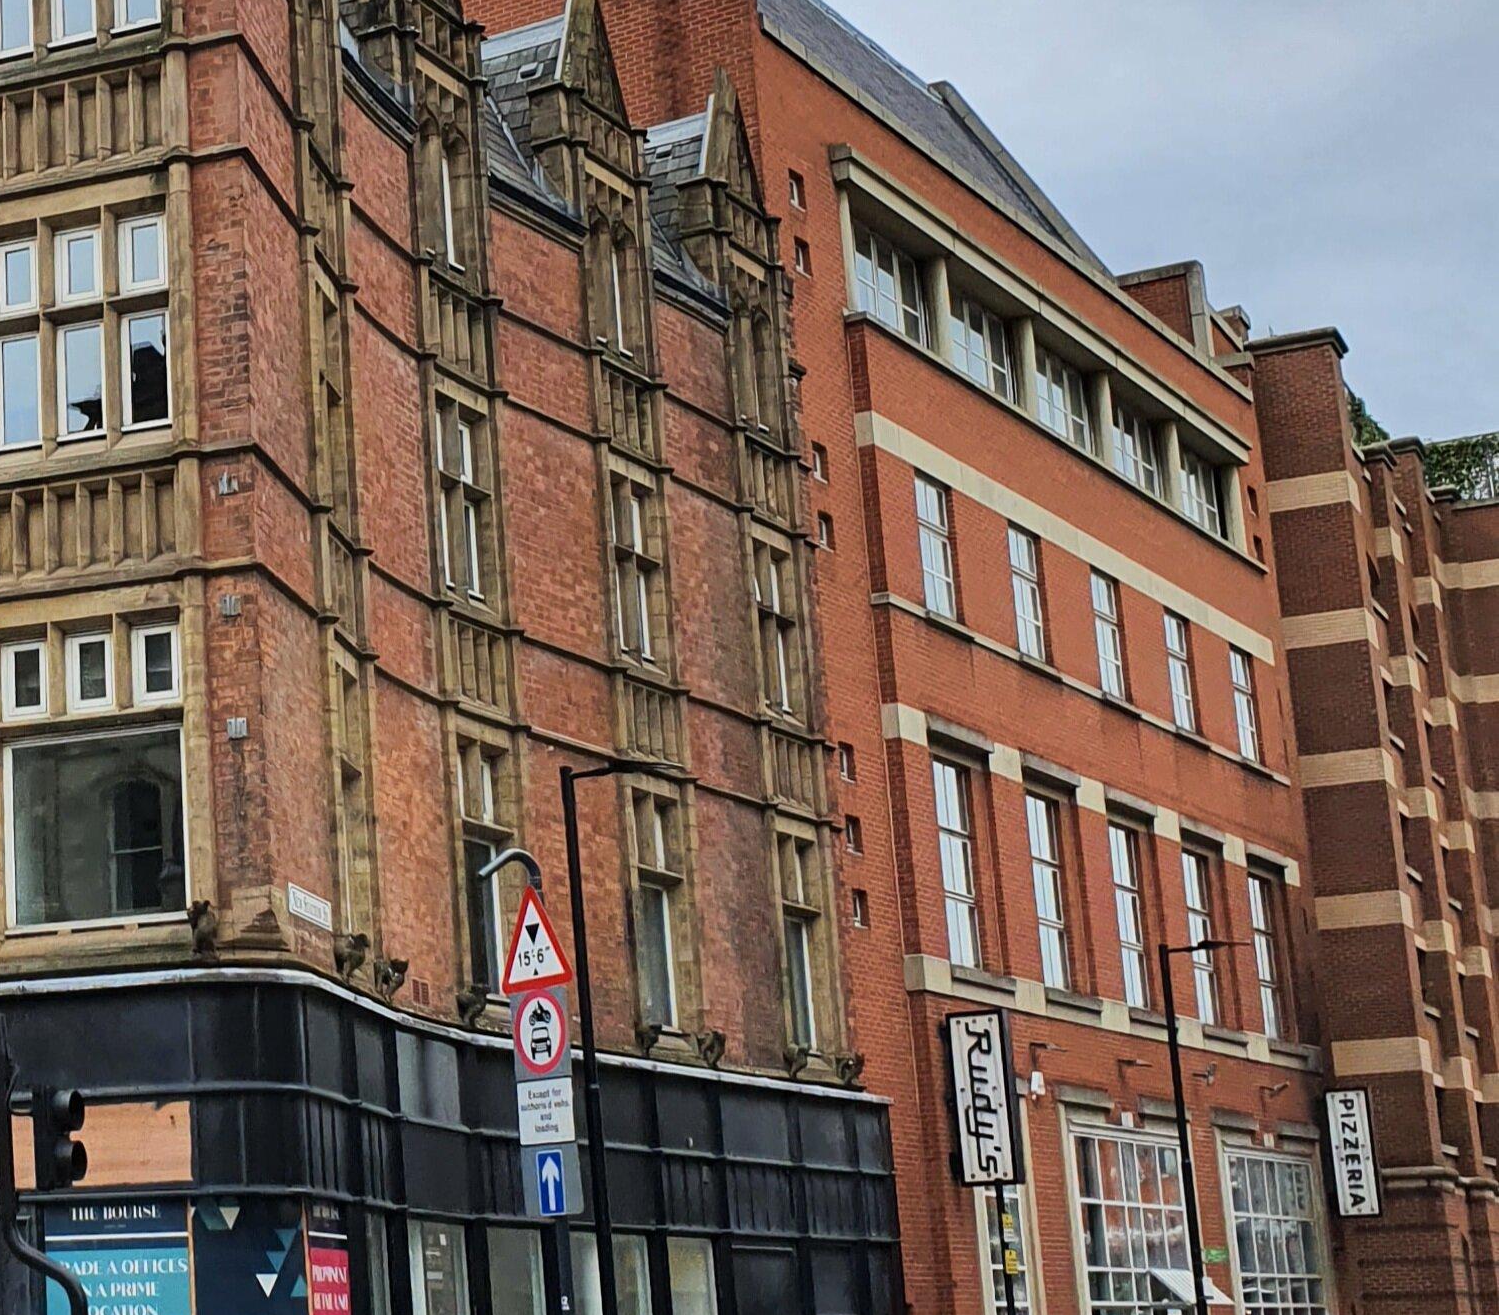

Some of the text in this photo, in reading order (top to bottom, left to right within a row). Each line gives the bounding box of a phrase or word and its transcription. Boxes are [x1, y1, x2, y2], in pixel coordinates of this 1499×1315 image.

[964, 1021, 1002, 1174] Rudy's
[1338, 1098, 1367, 1208] PIZZERIA
[70, 1204, 162, 1222] THE BOURSE
[106, 1260, 119, 1276] A
[121, 1257, 189, 1275] OFFICES
[95, 1282, 108, 1298] A
[110, 1281, 161, 1298] PRIME
